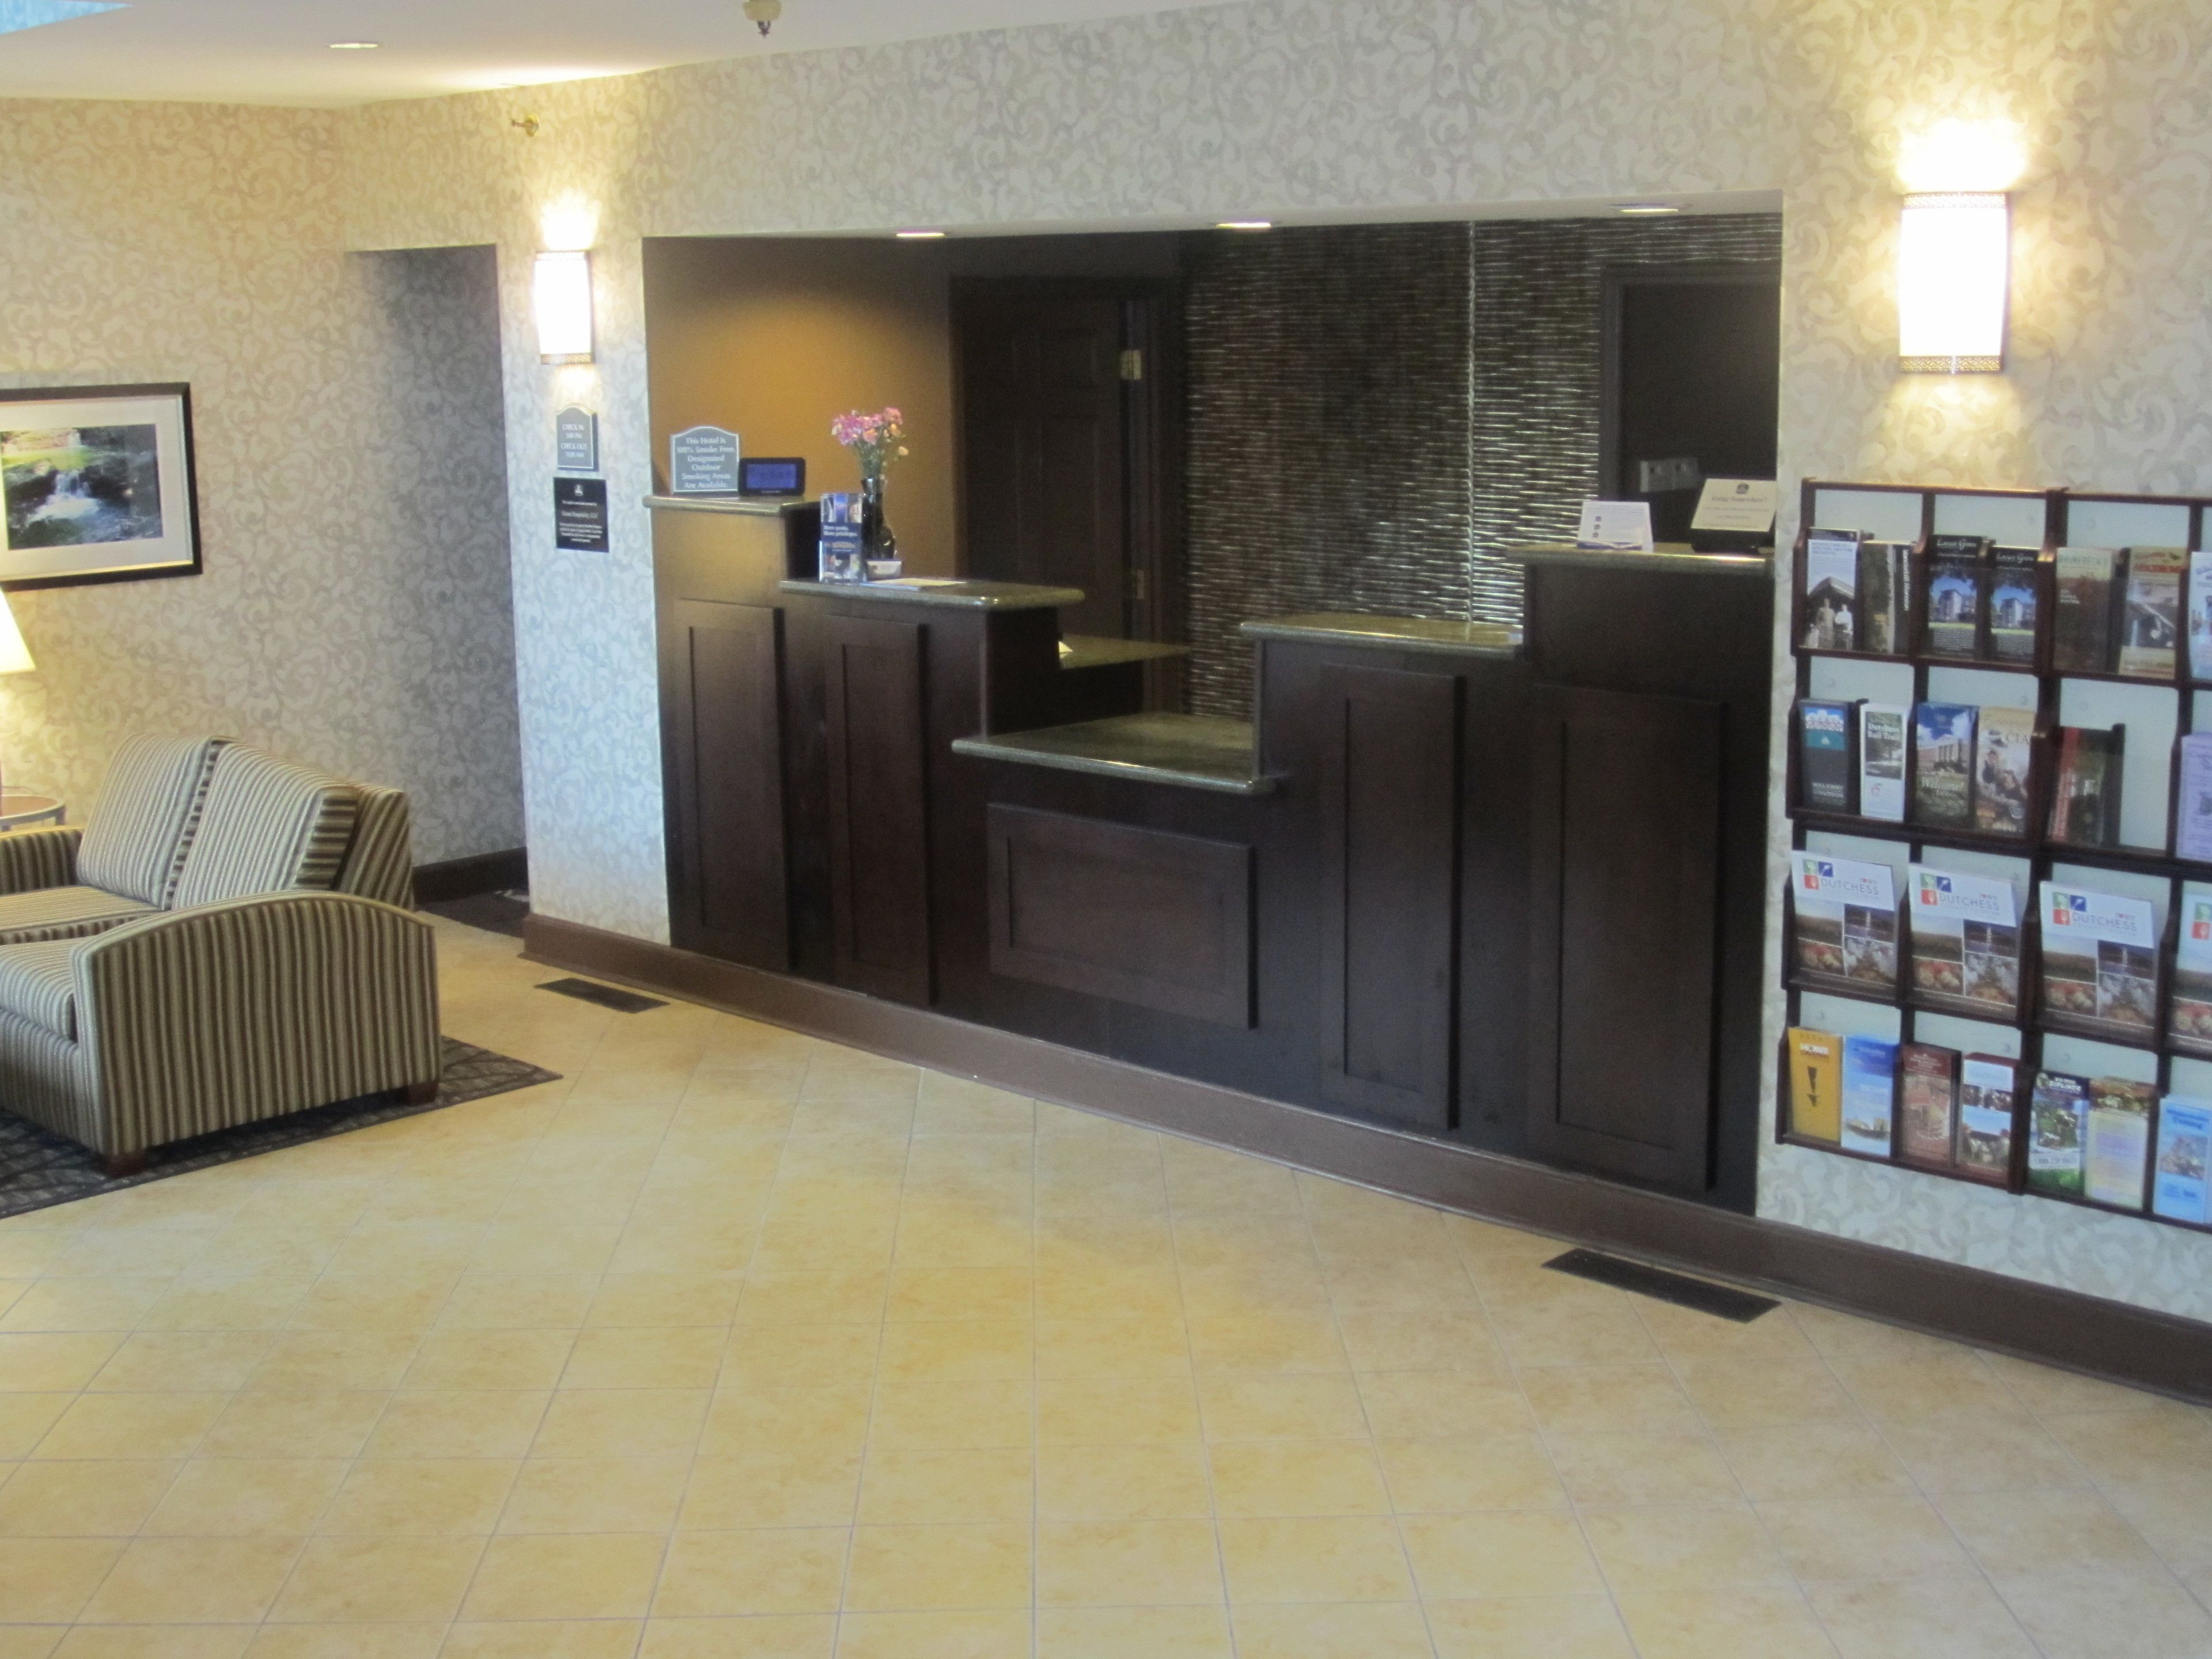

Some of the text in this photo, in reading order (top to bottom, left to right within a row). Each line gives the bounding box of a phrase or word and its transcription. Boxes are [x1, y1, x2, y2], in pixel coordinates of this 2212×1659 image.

[1821, 878, 1878, 895] DUTCHESS
[1940, 893, 1999, 911] DUTCHESS
[2073, 912, 2137, 932] DUTCHESS
